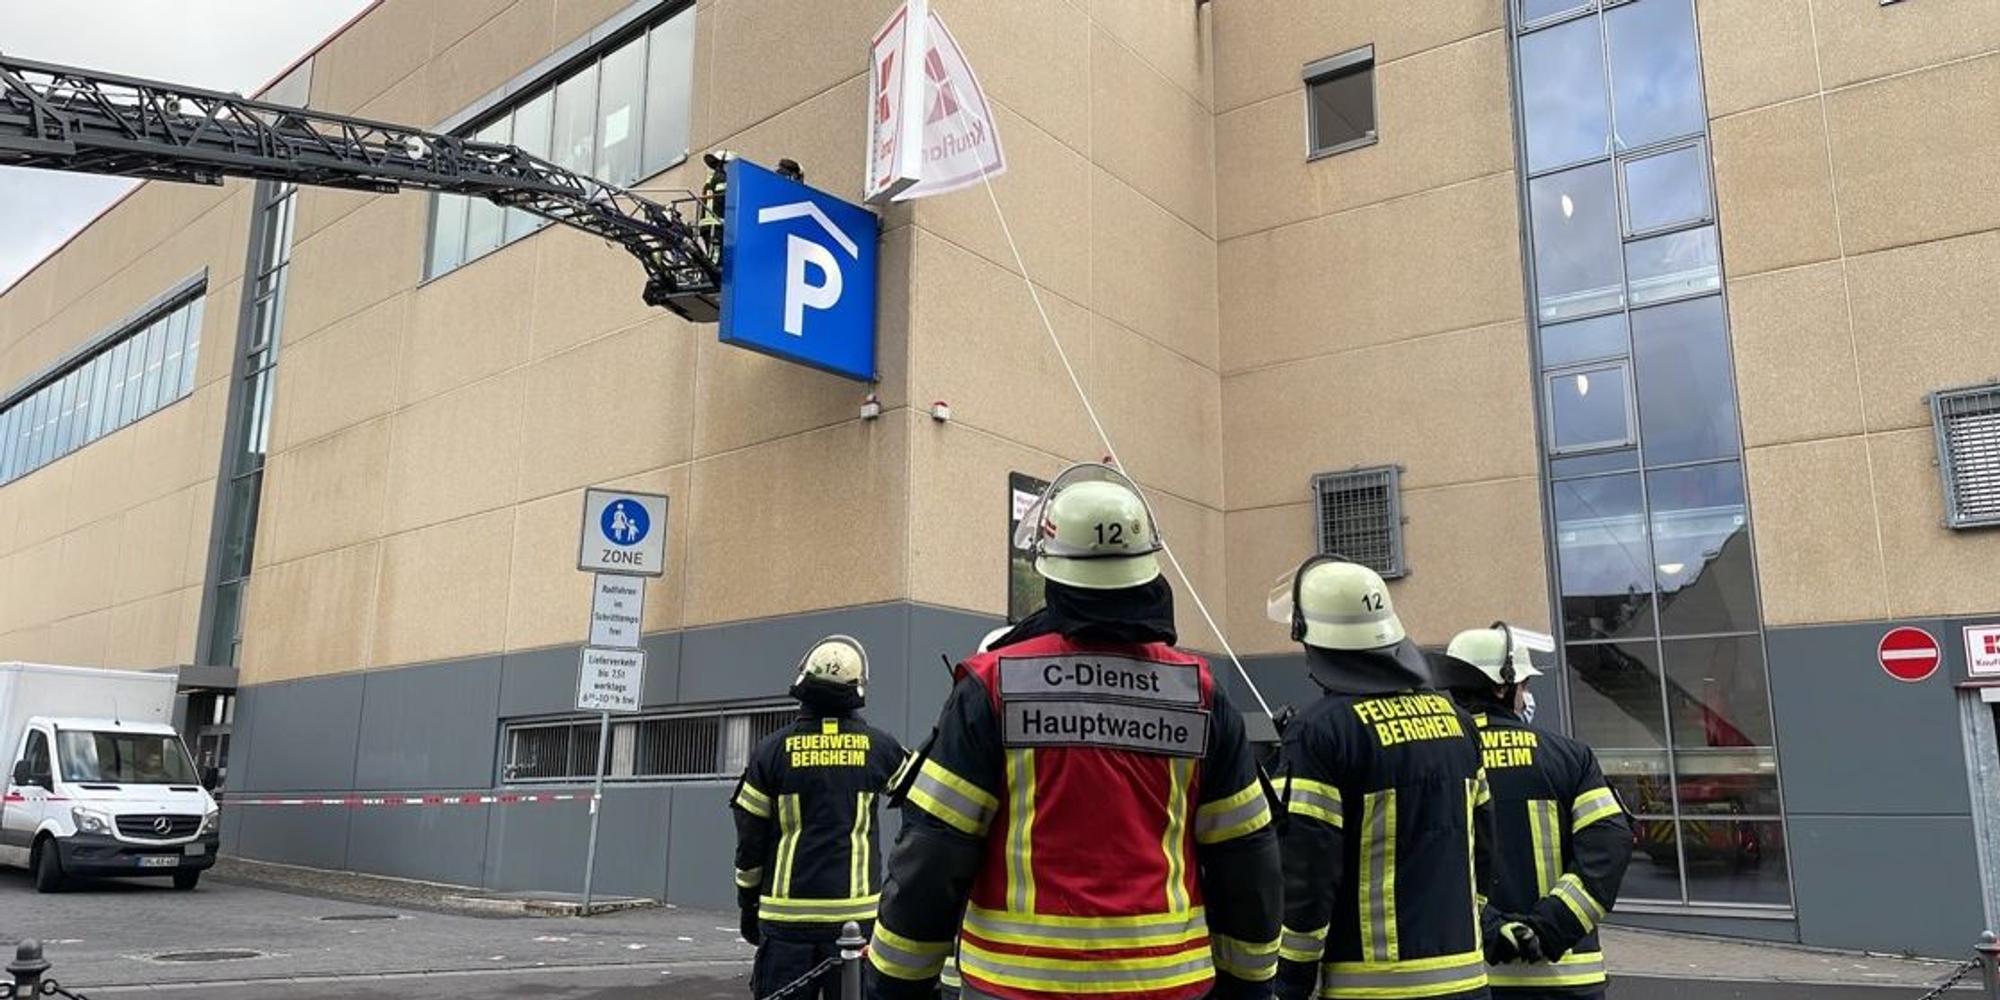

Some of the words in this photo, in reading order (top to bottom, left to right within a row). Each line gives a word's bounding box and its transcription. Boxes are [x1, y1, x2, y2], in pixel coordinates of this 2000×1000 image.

[784, 233, 843, 337] P
[1094, 522, 1123, 545] 12
[601, 549, 643, 565] ZONE
[601, 584, 637, 595] Radfahren
[1361, 592, 1384, 613] 12
[609, 626, 622, 635] frei
[588, 655, 637, 666] Lieferverkehr
[598, 668, 609, 678] bis
[825, 663, 840, 676] 12
[1043, 663, 1160, 693] C-Dienst
[594, 682, 627, 693] werktags
[1022, 709, 1189, 744] Hauptwache
[1374, 715, 1464, 747] BERGHEIM
[785, 733, 870, 752] FEUERWEHR
[791, 750, 866, 767] BERGHEIM
